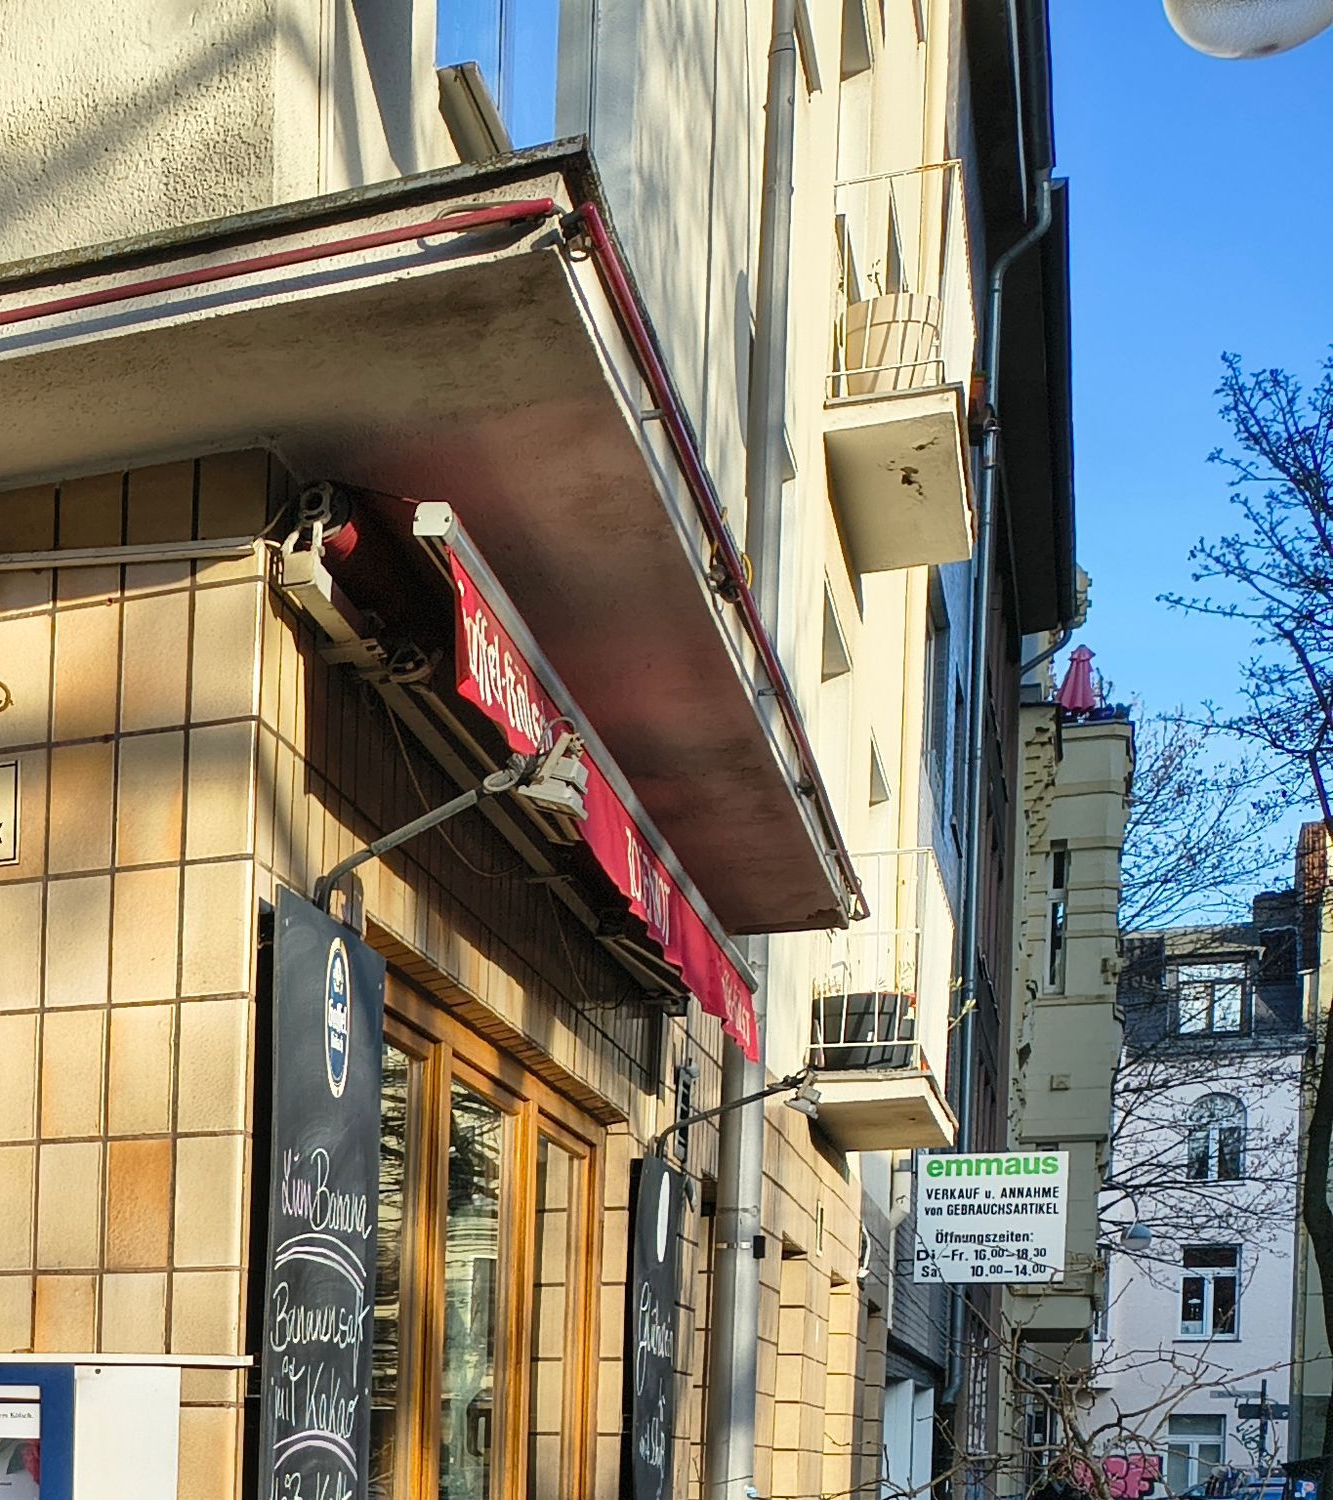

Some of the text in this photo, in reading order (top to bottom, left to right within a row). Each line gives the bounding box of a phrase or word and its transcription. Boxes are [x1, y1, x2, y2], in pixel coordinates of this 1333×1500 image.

[926, 1156, 1059, 1177] emmaus
[309, 1148, 372, 1239] Banana
[926, 1186, 1060, 1200] VERKAUF u. ANNAHME
[924, 1202, 1059, 1216] von GEBRAUCHSARTIKEL
[935, 1229, 1034, 1245] Öffnungszeiten:
[305, 1361, 360, 1439] Kakao
